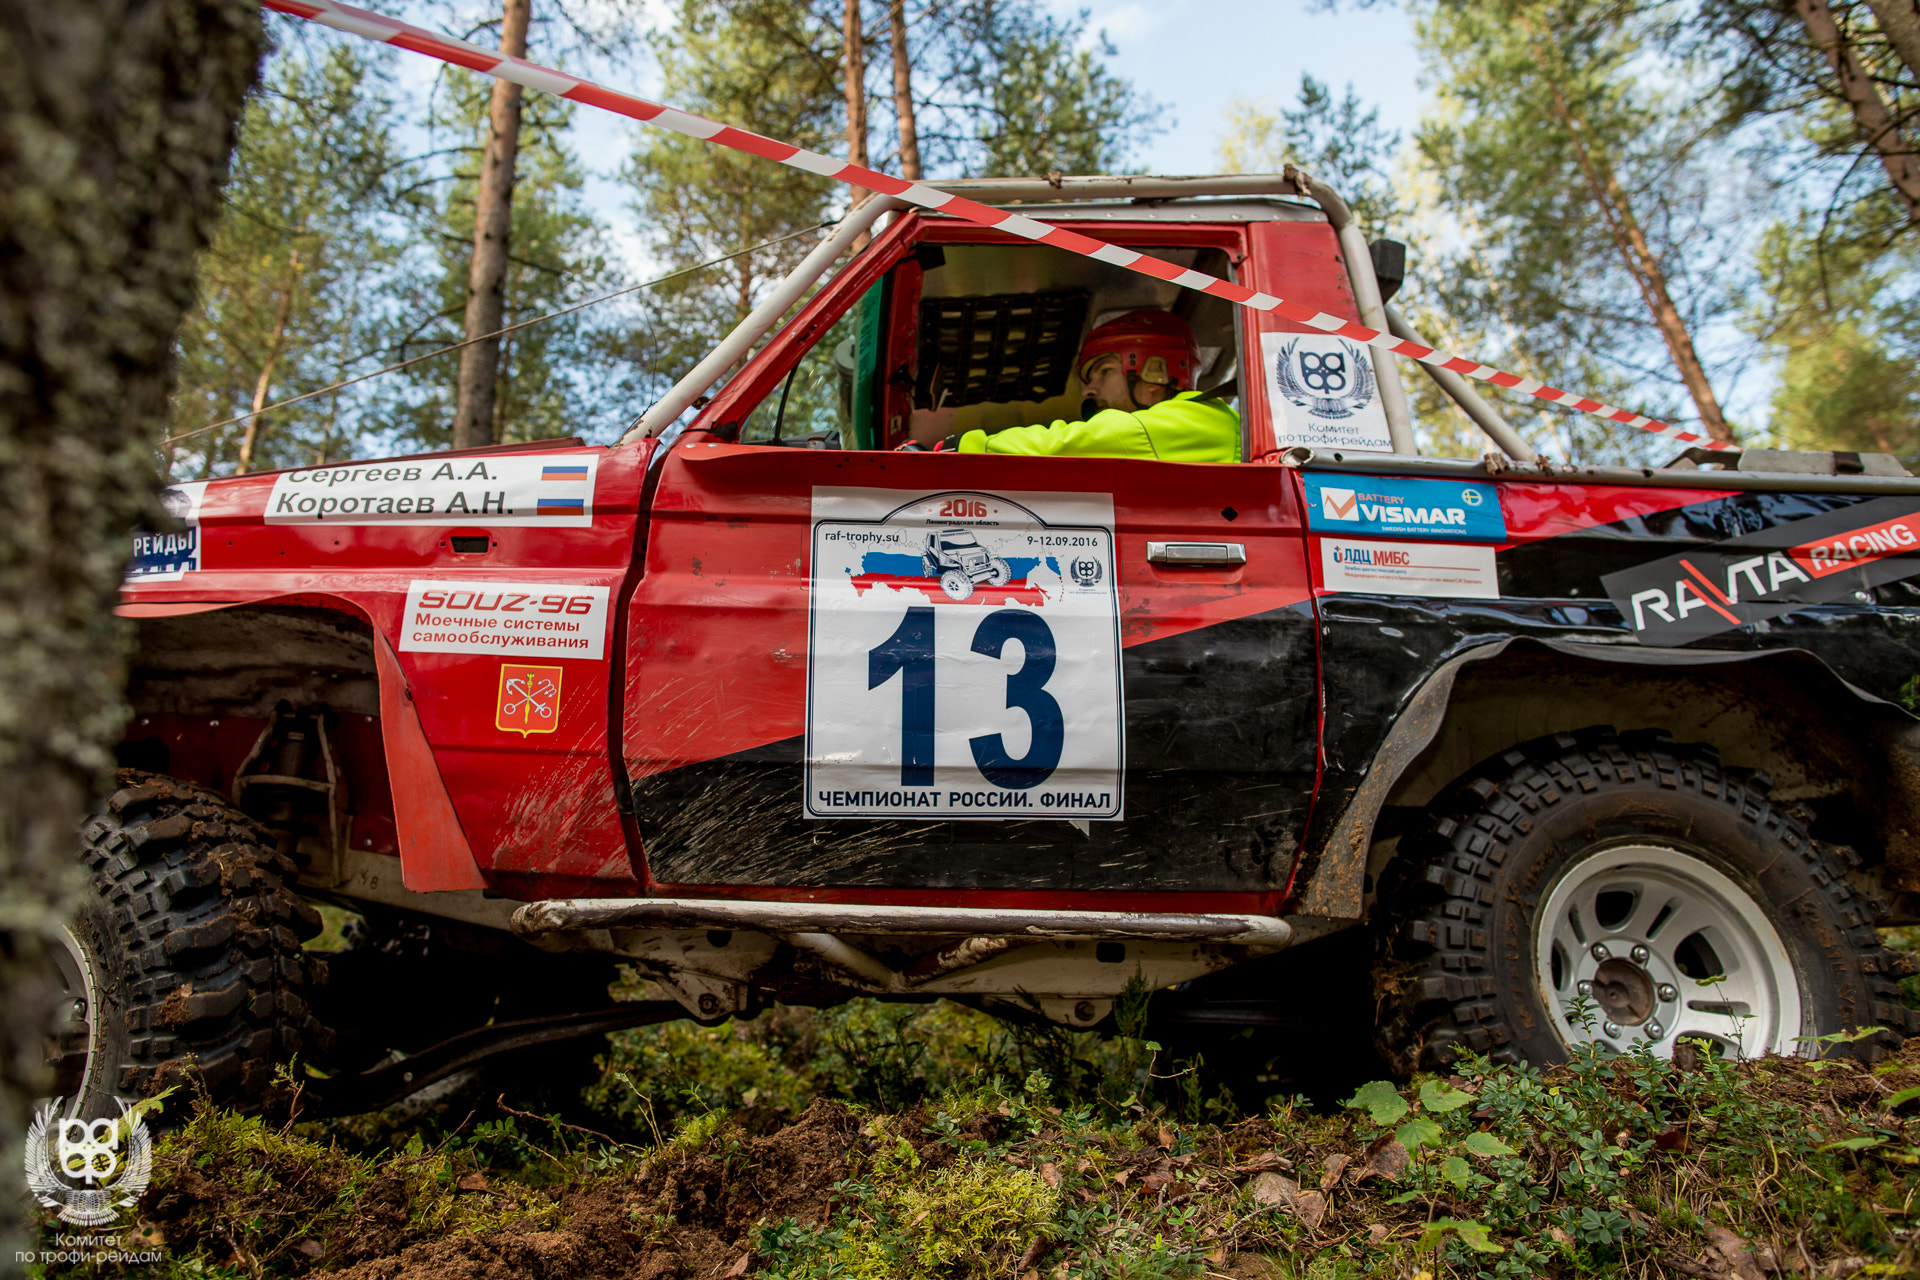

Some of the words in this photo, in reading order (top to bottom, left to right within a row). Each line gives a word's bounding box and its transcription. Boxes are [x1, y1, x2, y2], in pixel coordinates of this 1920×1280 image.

[1308, 422, 1359, 435] Комитет
[1278, 433, 1295, 443] по
[1298, 433, 1393, 447] трофи-рейдам
[288, 466, 422, 487] Сергеев
[431, 461, 498, 481] А.А.
[276, 492, 435, 519] Коротаев
[445, 491, 514, 515] А.Н.
[1357, 492, 1405, 504] BATTERY
[939, 499, 988, 518] 2016
[1359, 503, 1467, 525] VISMAR
[925, 518, 974, 526] Ленинградская
[824, 530, 900, 544] raf-trophy.su
[1026, 535, 1098, 547] 9-12.09.2016
[1809, 523, 1917, 571] RACING
[1344, 548, 1371, 565] ЛДЦ
[1373, 550, 1410, 566] МИБС
[418, 589, 595, 615] SOUZ-96
[415, 612, 498, 628] Моечные
[503, 618, 580, 632] системы
[412, 631, 589, 648] самообслуживания
[867, 606, 1064, 790] 13
[818, 791, 941, 807] ЧЕМПИОНАТ
[949, 791, 1033, 808] РОССИИ.
[1040, 791, 1111, 809] ФИНАЛ
